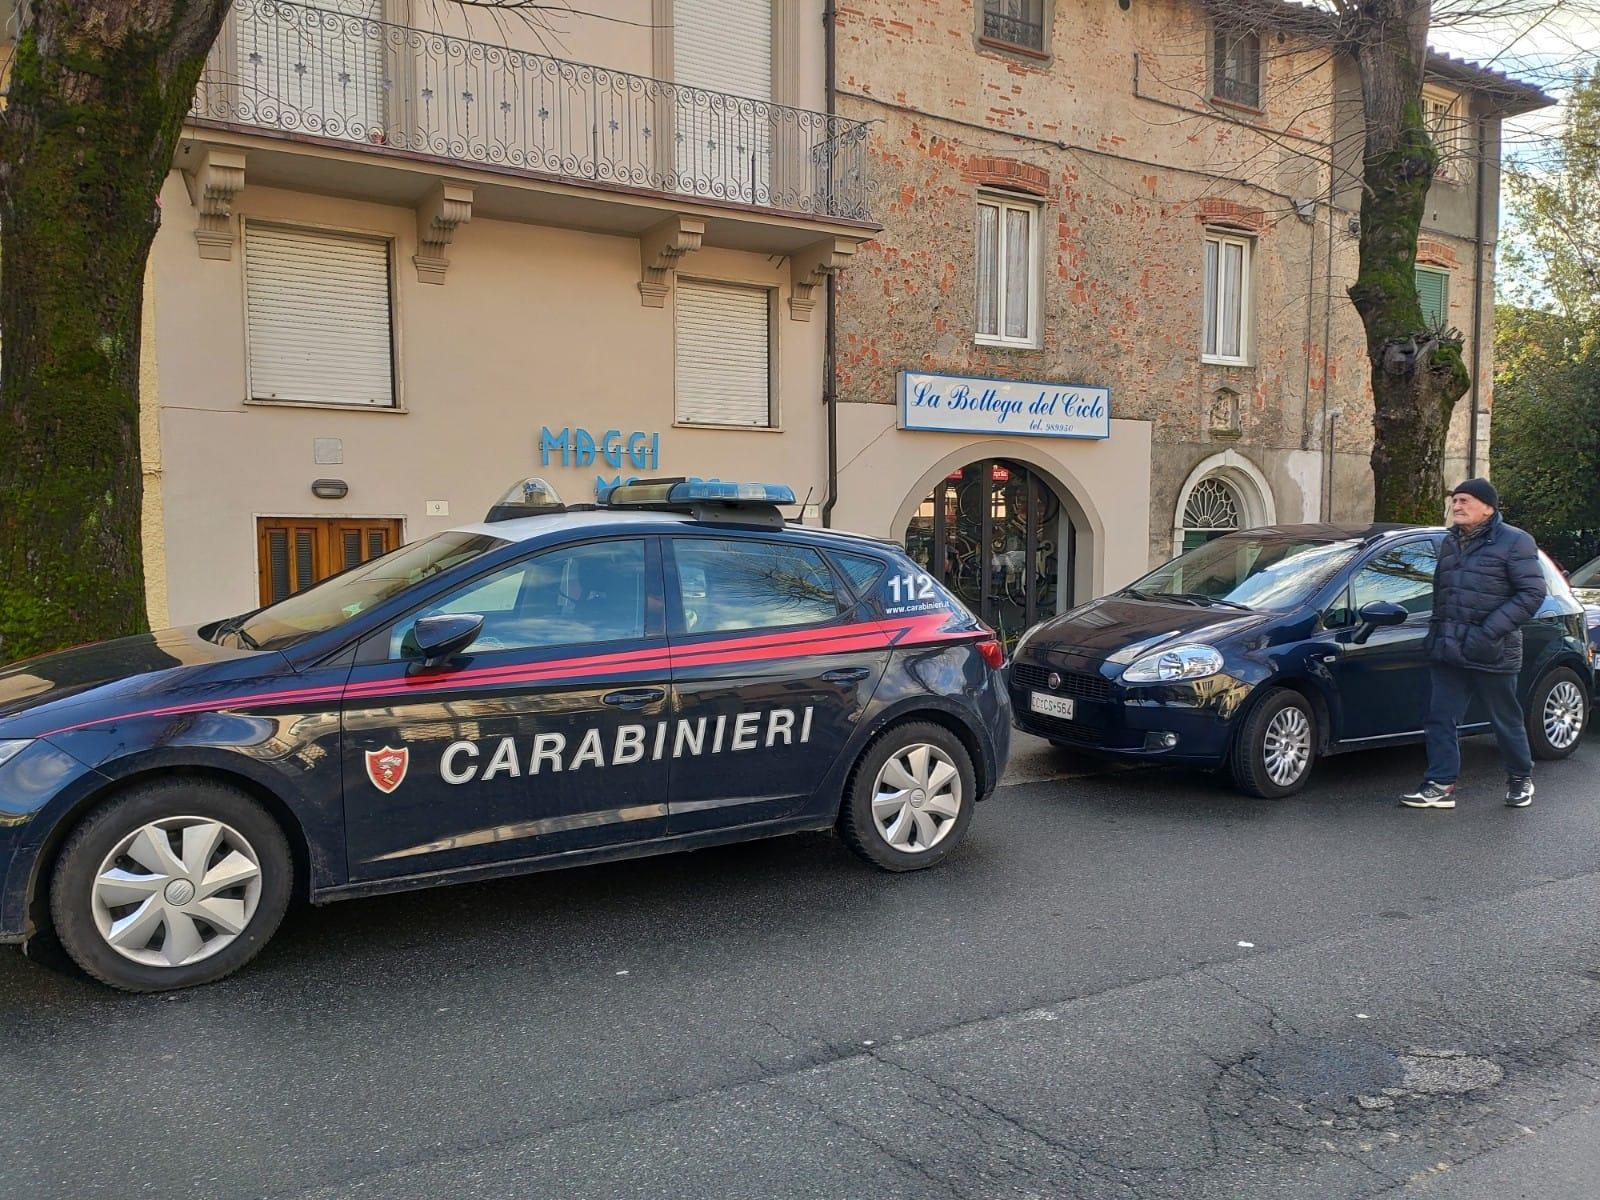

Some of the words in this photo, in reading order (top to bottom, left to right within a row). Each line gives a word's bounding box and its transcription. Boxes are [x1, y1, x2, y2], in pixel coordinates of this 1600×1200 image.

[911, 382, 940, 408] La
[947, 384, 1023, 423] Bottega
[1028, 391, 1059, 416] del
[1061, 392, 1104, 418] Ciclo
[1029, 419, 1043, 431] tel.
[541, 426, 660, 469] MAGGI
[887, 573, 936, 603] 112
[885, 601, 951, 614] www.carabinieri.it
[439, 706, 815, 785] CARABINIERI
